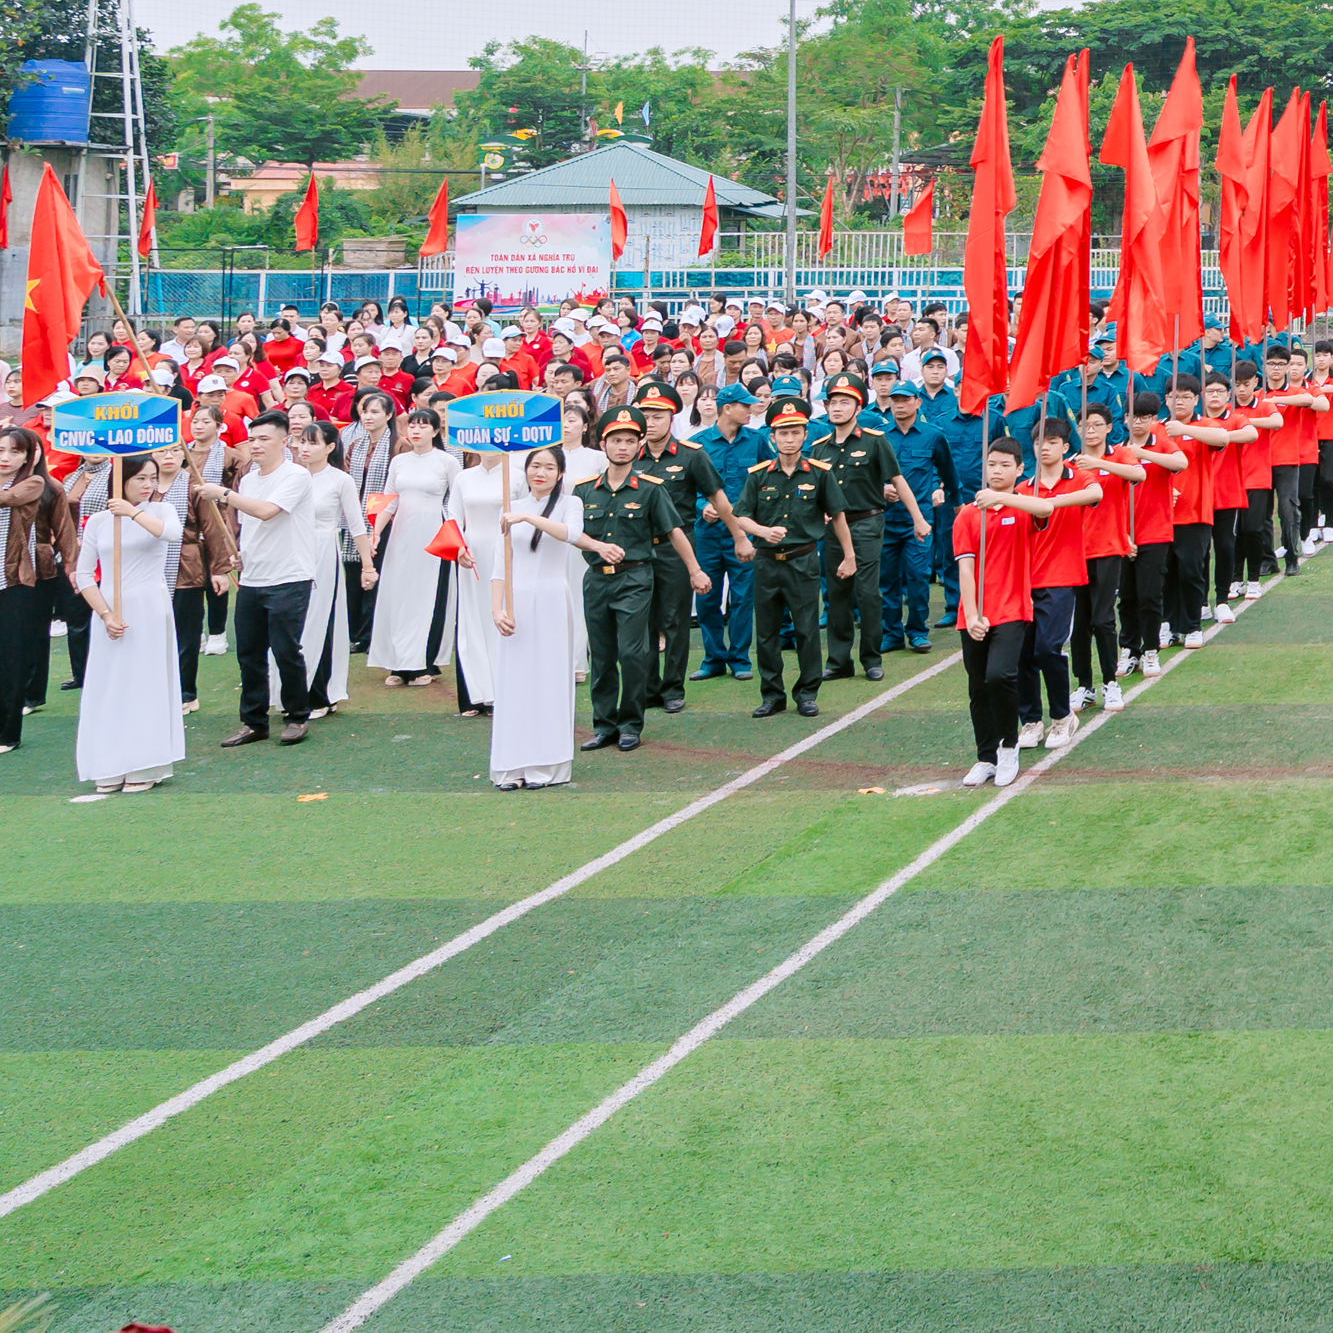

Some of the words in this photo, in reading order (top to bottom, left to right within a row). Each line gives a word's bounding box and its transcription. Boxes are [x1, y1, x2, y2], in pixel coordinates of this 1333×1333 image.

[506, 266, 523, 274] THEO
[94, 400, 139, 421] KHỐI
[483, 398, 525, 419] KHỐI
[59, 430, 96, 447] CNVC
[107, 428, 134, 445] LAO
[136, 425, 174, 447] ĐỘNG
[456, 426, 491, 445] QUÂN
[494, 426, 512, 446] SỰ
[522, 426, 553, 443] DQTV
